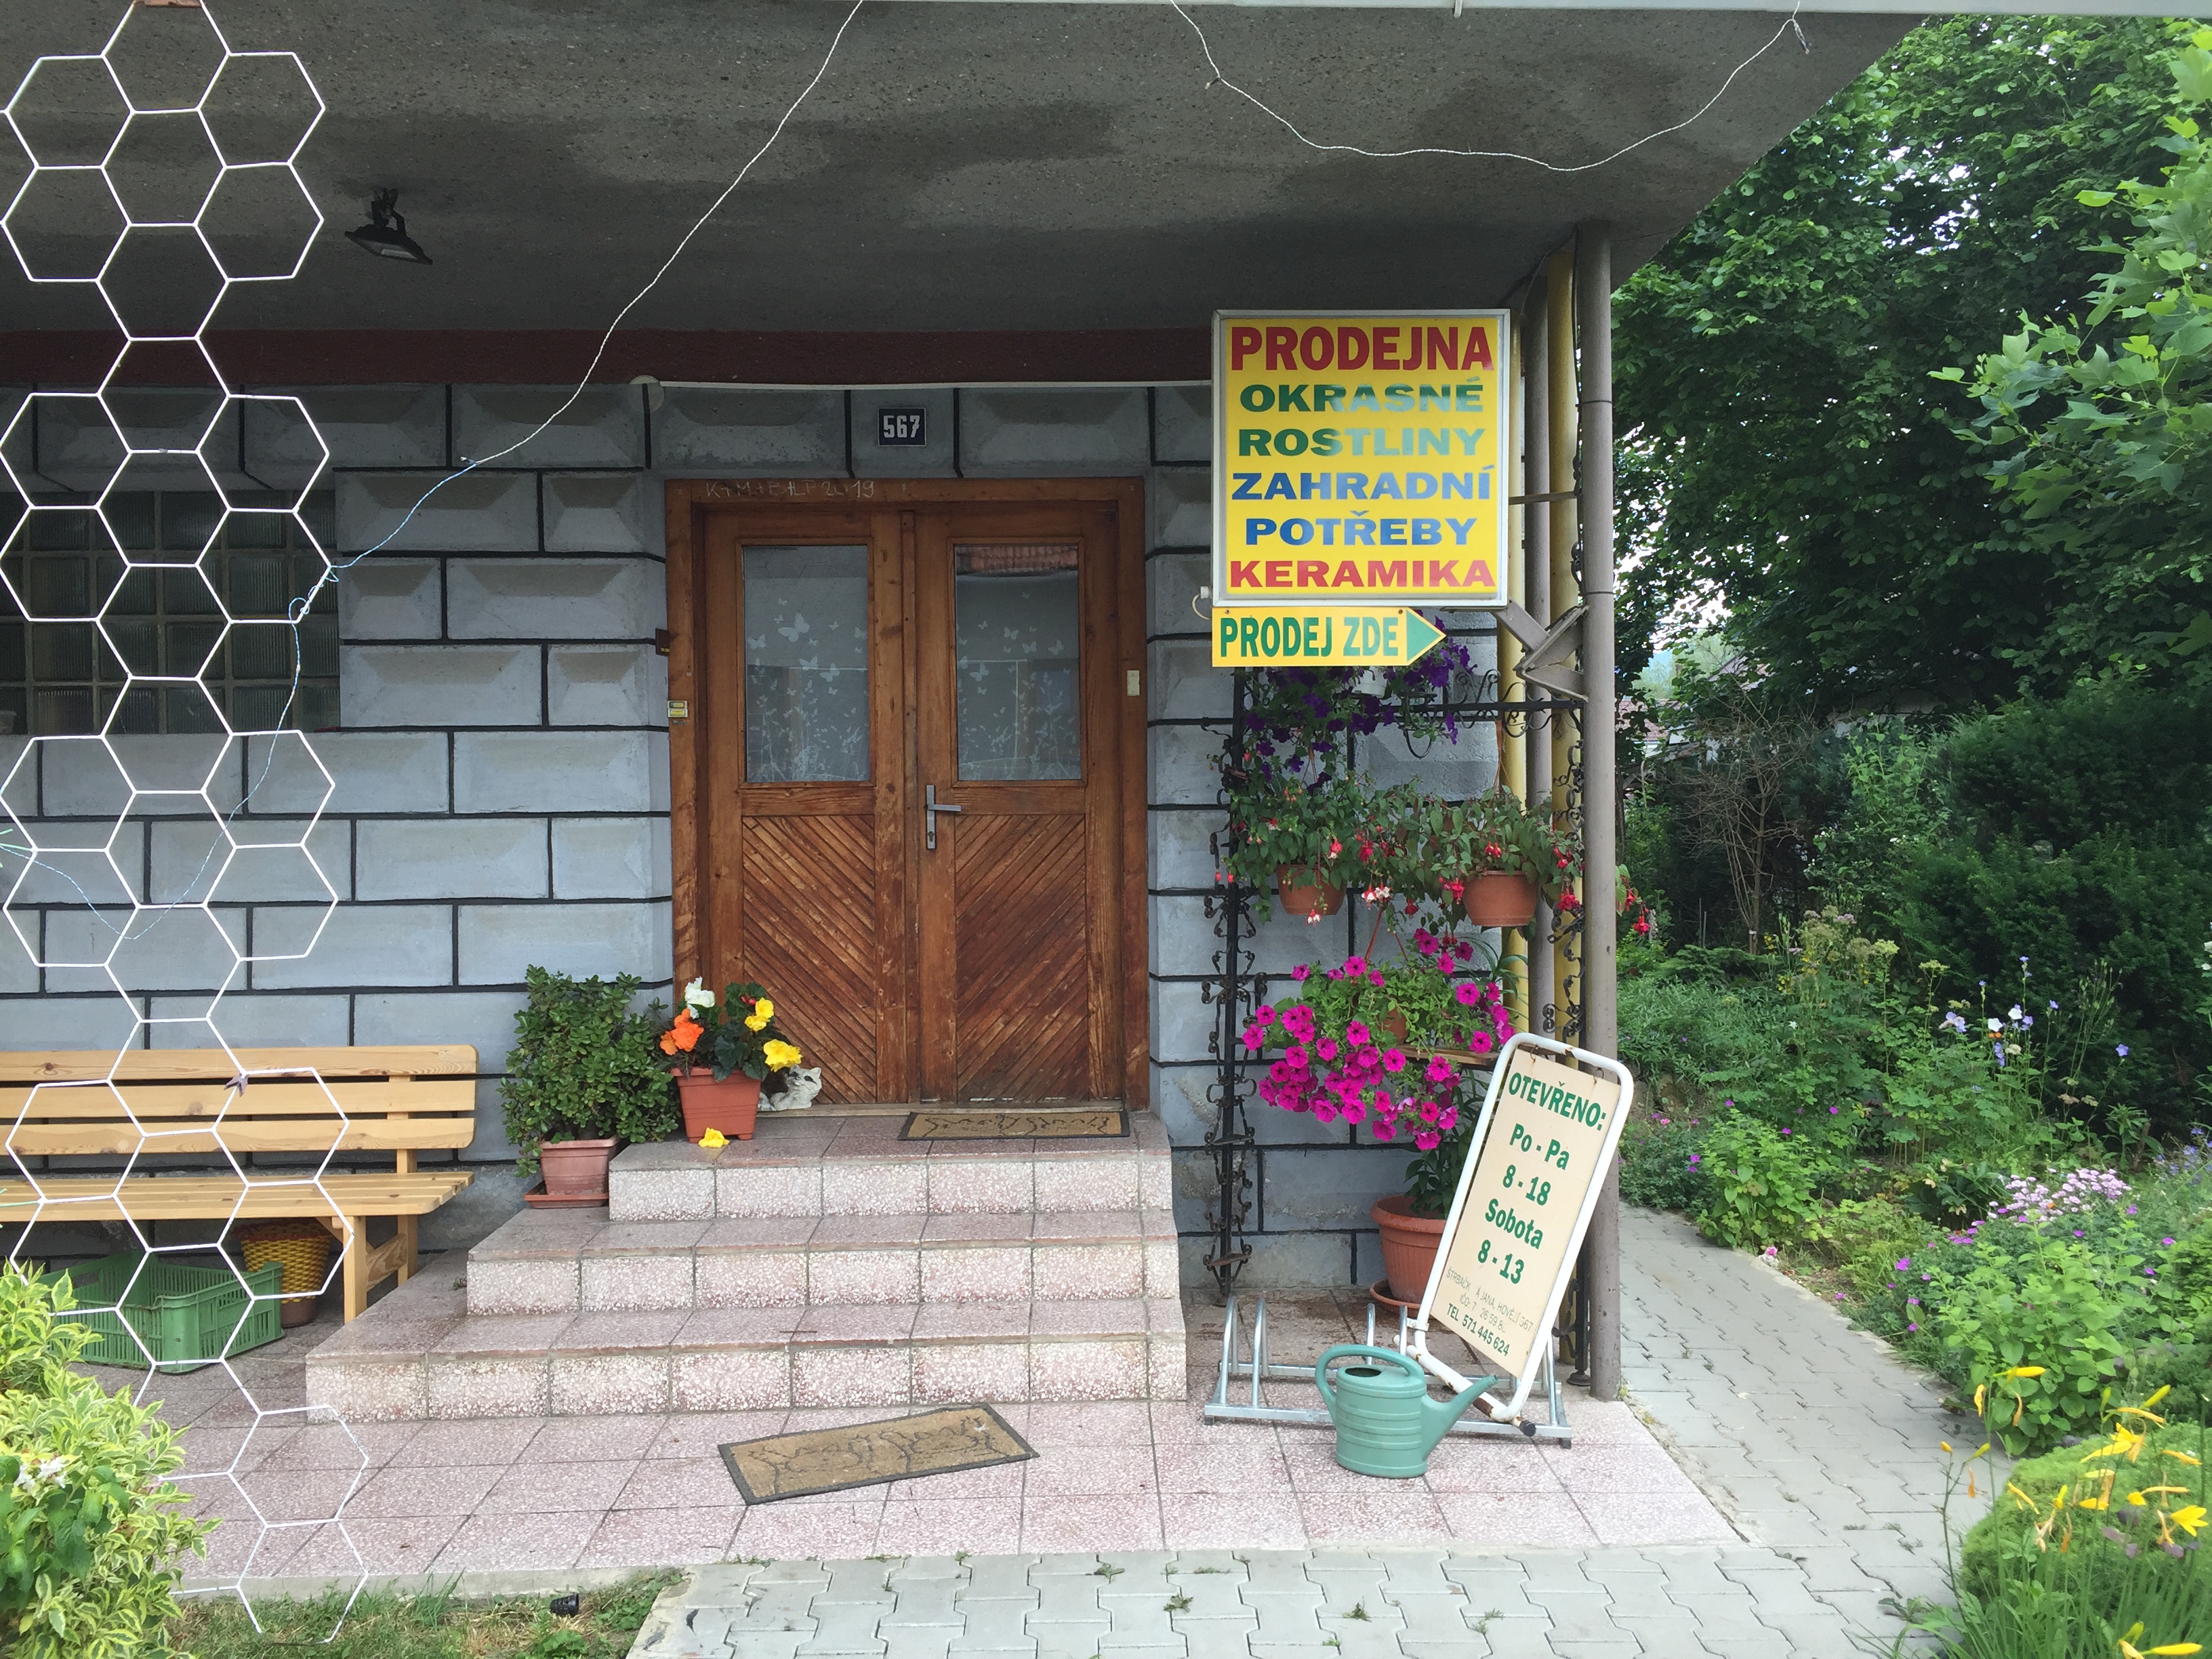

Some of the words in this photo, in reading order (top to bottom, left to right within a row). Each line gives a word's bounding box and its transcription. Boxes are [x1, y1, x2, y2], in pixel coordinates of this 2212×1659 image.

[1231, 326, 1495, 371] PRODEJNA
[1240, 376, 1484, 413] OKRASNÉ
[883, 415, 920, 438] 567
[1238, 428, 1486, 457] ROSTLINY
[1231, 464, 1495, 501] ZAHRADNÍ
[1246, 510, 1478, 546] POTŘEBY
[1230, 560, 1495, 588] KERAMIKA
[1220, 616, 1332, 657] PRODEJ
[1343, 616, 1399, 657] ZDE
[1509, 1072, 1607, 1131] OTEVŘENO:
[1509, 1123, 1532, 1153] Po
[1544, 1139, 1570, 1170] Pa
[1502, 1164, 1517, 1189] 8
[1525, 1176, 1551, 1206] 18
[1485, 1198, 1544, 1250] Sobota
[1477, 1240, 1491, 1264] 8
[1499, 1253, 1525, 1284] 13
[1446, 1303, 1460, 1322] TEL
[1462, 1315, 1477, 1334] 571
[1477, 1326, 1494, 1345] 445
[1493, 1336, 1510, 1356] 624
